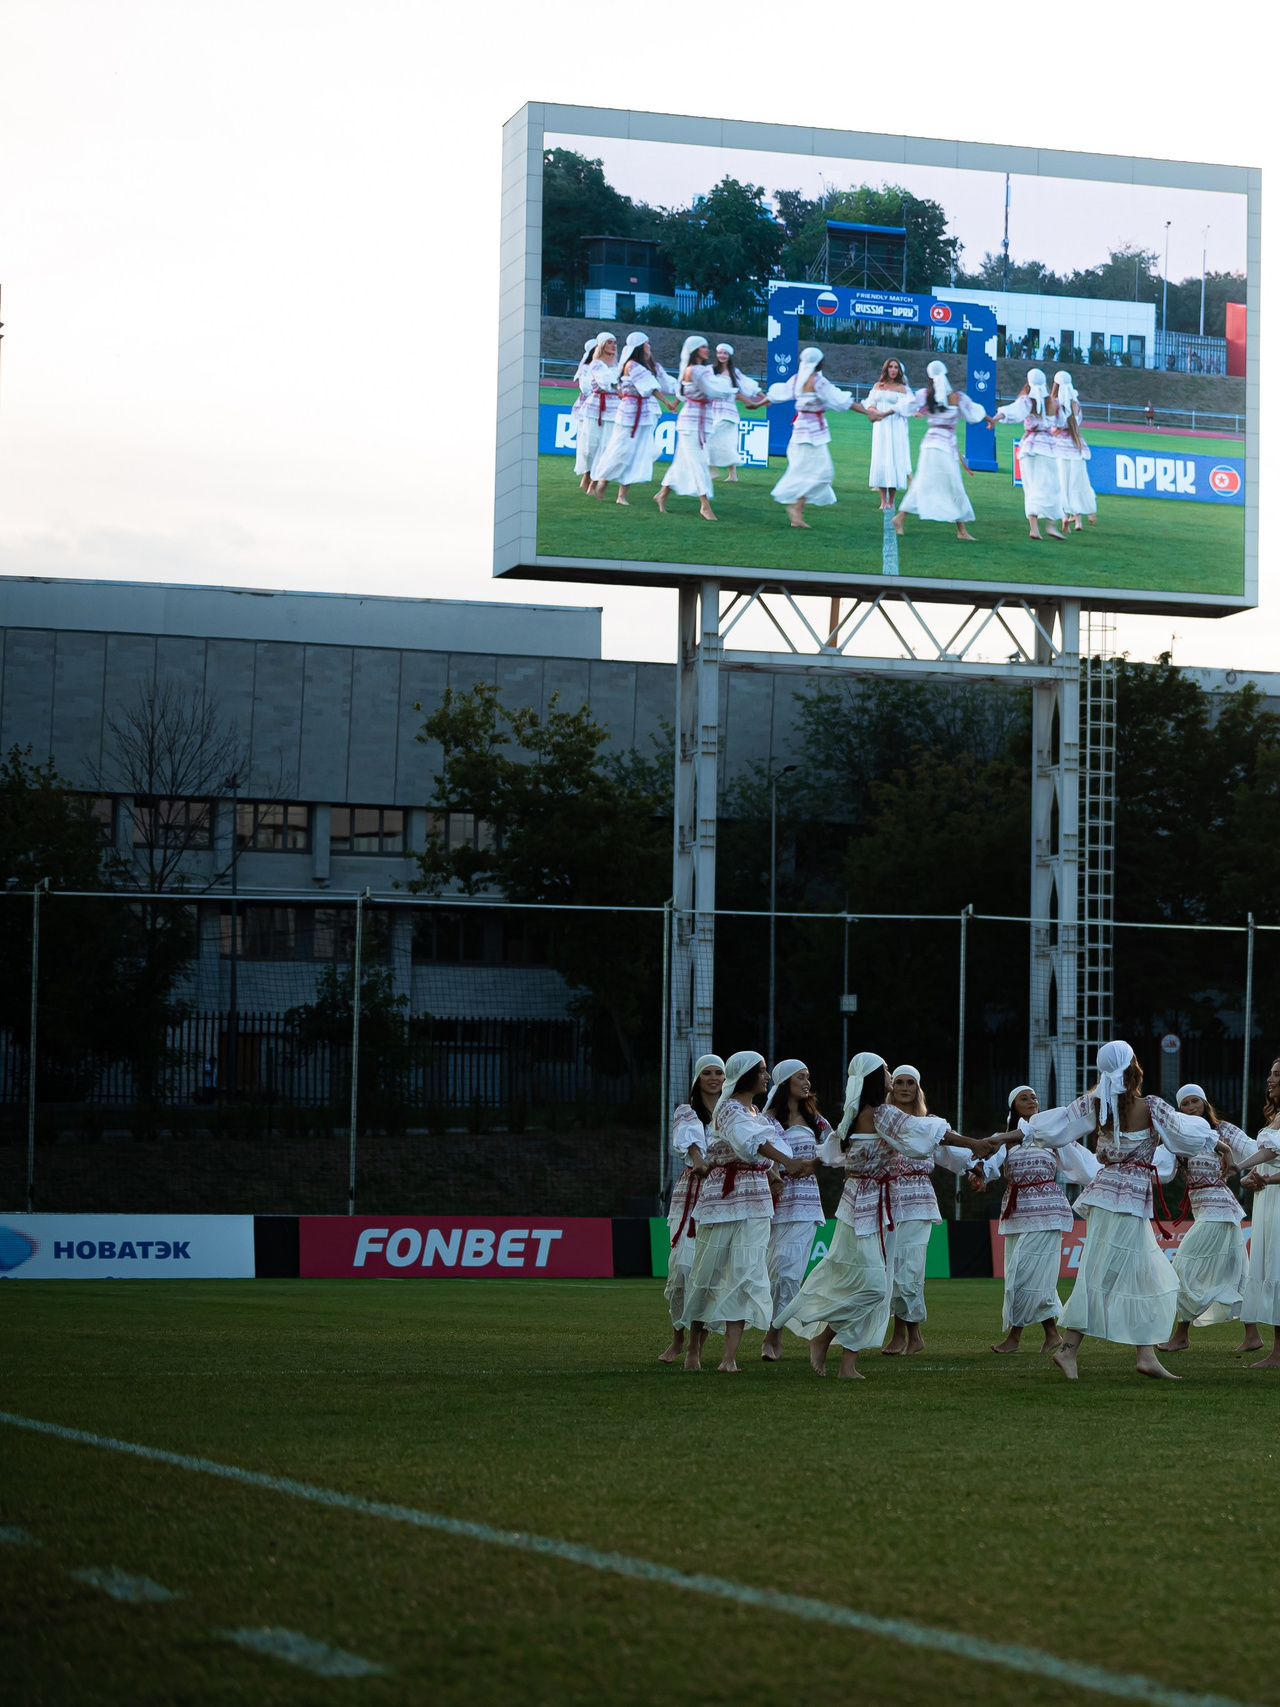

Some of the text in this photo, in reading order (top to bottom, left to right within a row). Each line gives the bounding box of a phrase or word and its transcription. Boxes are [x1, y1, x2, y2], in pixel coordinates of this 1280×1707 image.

[856, 292, 914, 303] FRIENDLY MATCH
[1116, 454, 1196, 494] DPRK
[54, 1241, 191, 1259] НОВАТЭК
[353, 1228, 563, 1268] FONBET
